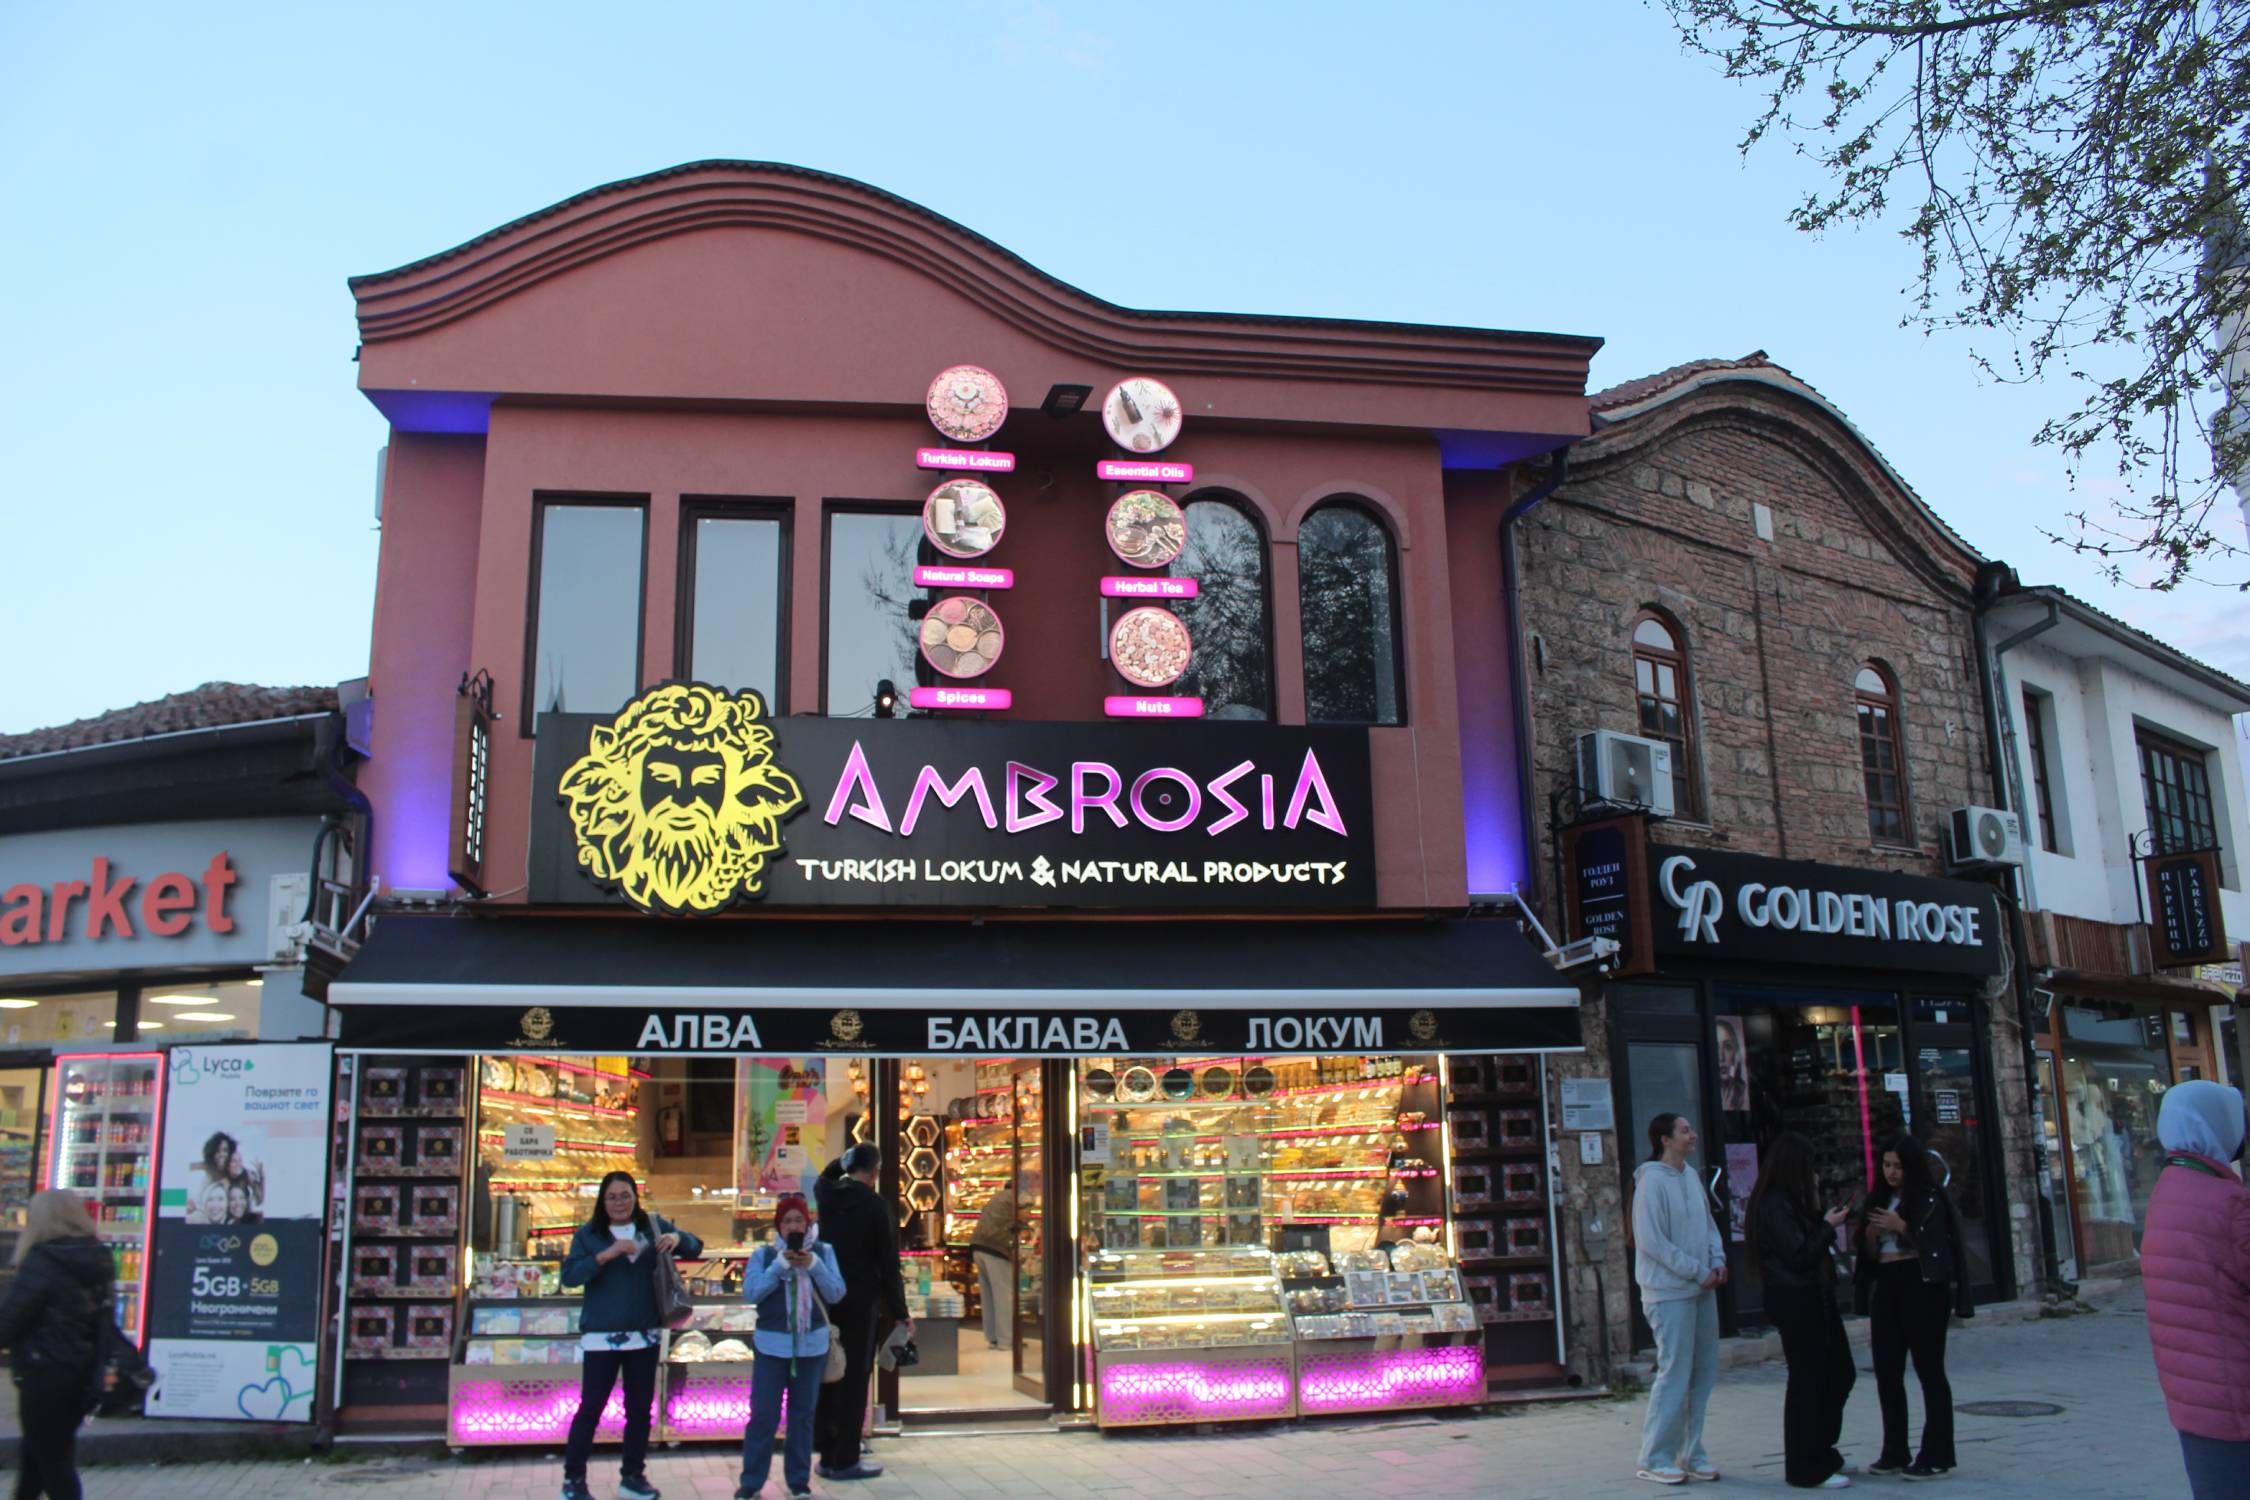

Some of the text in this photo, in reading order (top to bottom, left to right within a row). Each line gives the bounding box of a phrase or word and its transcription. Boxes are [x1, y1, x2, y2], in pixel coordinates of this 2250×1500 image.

[921, 452, 1011, 468] Turkish Lokum
[1106, 464, 1185, 478] Essential Oils
[922, 570, 1005, 585] Natural Soaps
[1115, 581, 1183, 594] Herbal Tea
[936, 691, 986, 705] Spices
[1136, 701, 1171, 713] Nuts
[824, 739, 1348, 838] AMBROSIA
[796, 855, 1348, 887] TURKISH LOKUM & NATURAL PRODUCTS
[1585, 911, 1624, 925] GOLDEN
[1738, 883, 1983, 946] GOLDEN ROSE
[1593, 924, 1617, 936] ROSE
[636, 1015, 762, 1049] АЛВА
[927, 1017, 1130, 1050] БАКЛАВА
[1246, 1016, 1383, 1049] ЛОКУМ
[204, 1056, 242, 1075] Lyca
[245, 1085, 318, 1099] Поврзете го
[244, 1101, 320, 1111] вашиот свет
[192, 1266, 240, 1296] 5GB
[250, 1277, 279, 1293] 5GB
[191, 1301, 278, 1316] Неограничени
